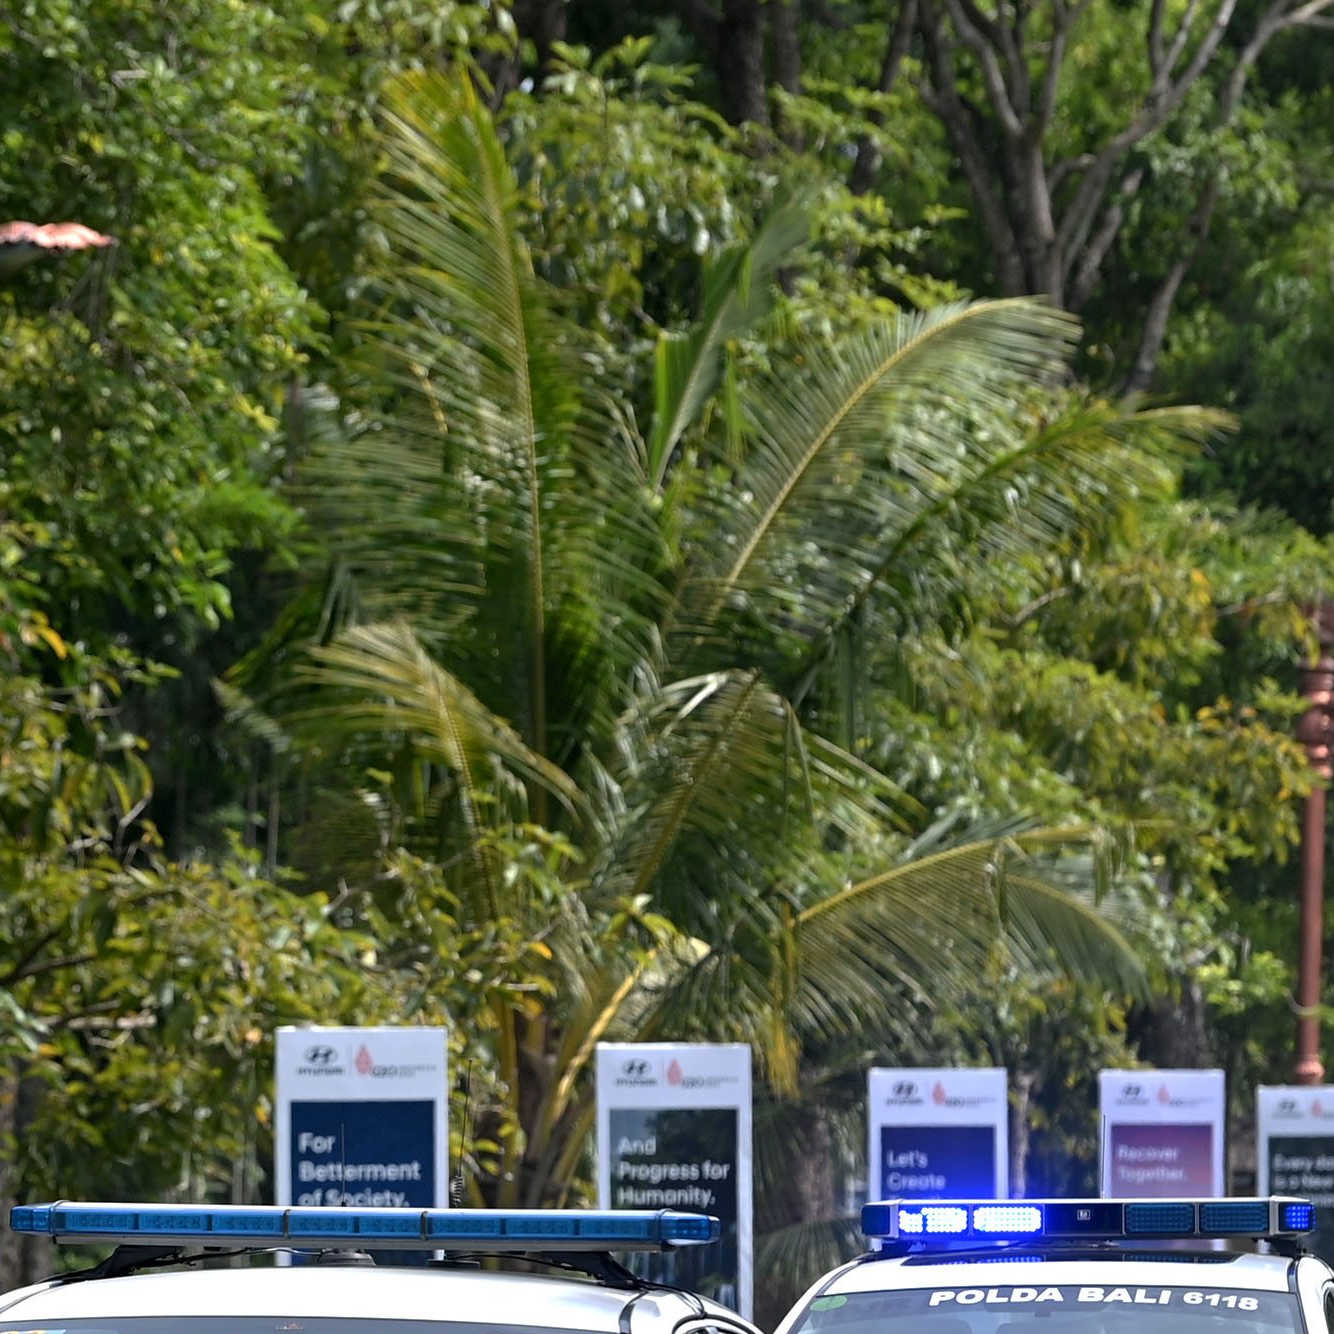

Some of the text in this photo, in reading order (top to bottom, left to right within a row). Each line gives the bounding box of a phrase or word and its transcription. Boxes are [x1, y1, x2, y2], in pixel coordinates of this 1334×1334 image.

[297, 1131, 336, 1153] For
[618, 1135, 657, 1155] And
[886, 1150, 928, 1168] Let's
[297, 1159, 422, 1182] Betterment
[618, 1159, 731, 1184] Progress for
[886, 1171, 947, 1191] Create
[297, 1187, 323, 1206] of
[928, 1287, 1260, 1311] POLDA BALI 6118
